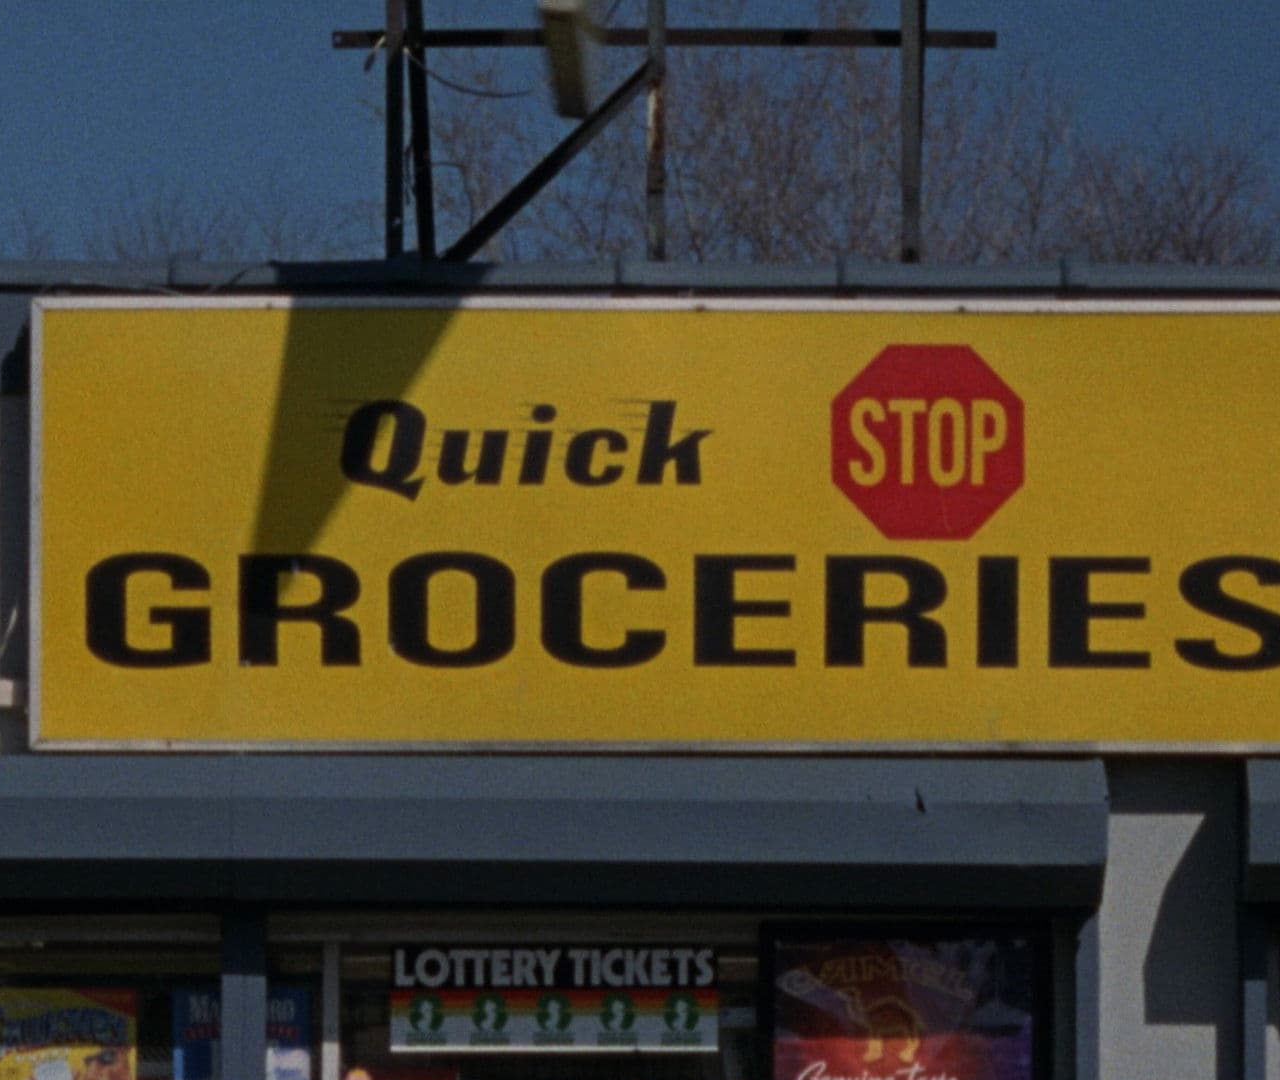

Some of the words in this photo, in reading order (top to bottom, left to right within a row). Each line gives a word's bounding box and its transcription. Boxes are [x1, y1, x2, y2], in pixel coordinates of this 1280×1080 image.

[340, 398, 716, 500] Quick
[848, 396, 1009, 488] STOP
[394, 947, 559, 988] LOTTERY
[569, 947, 715, 988] TICKETS
